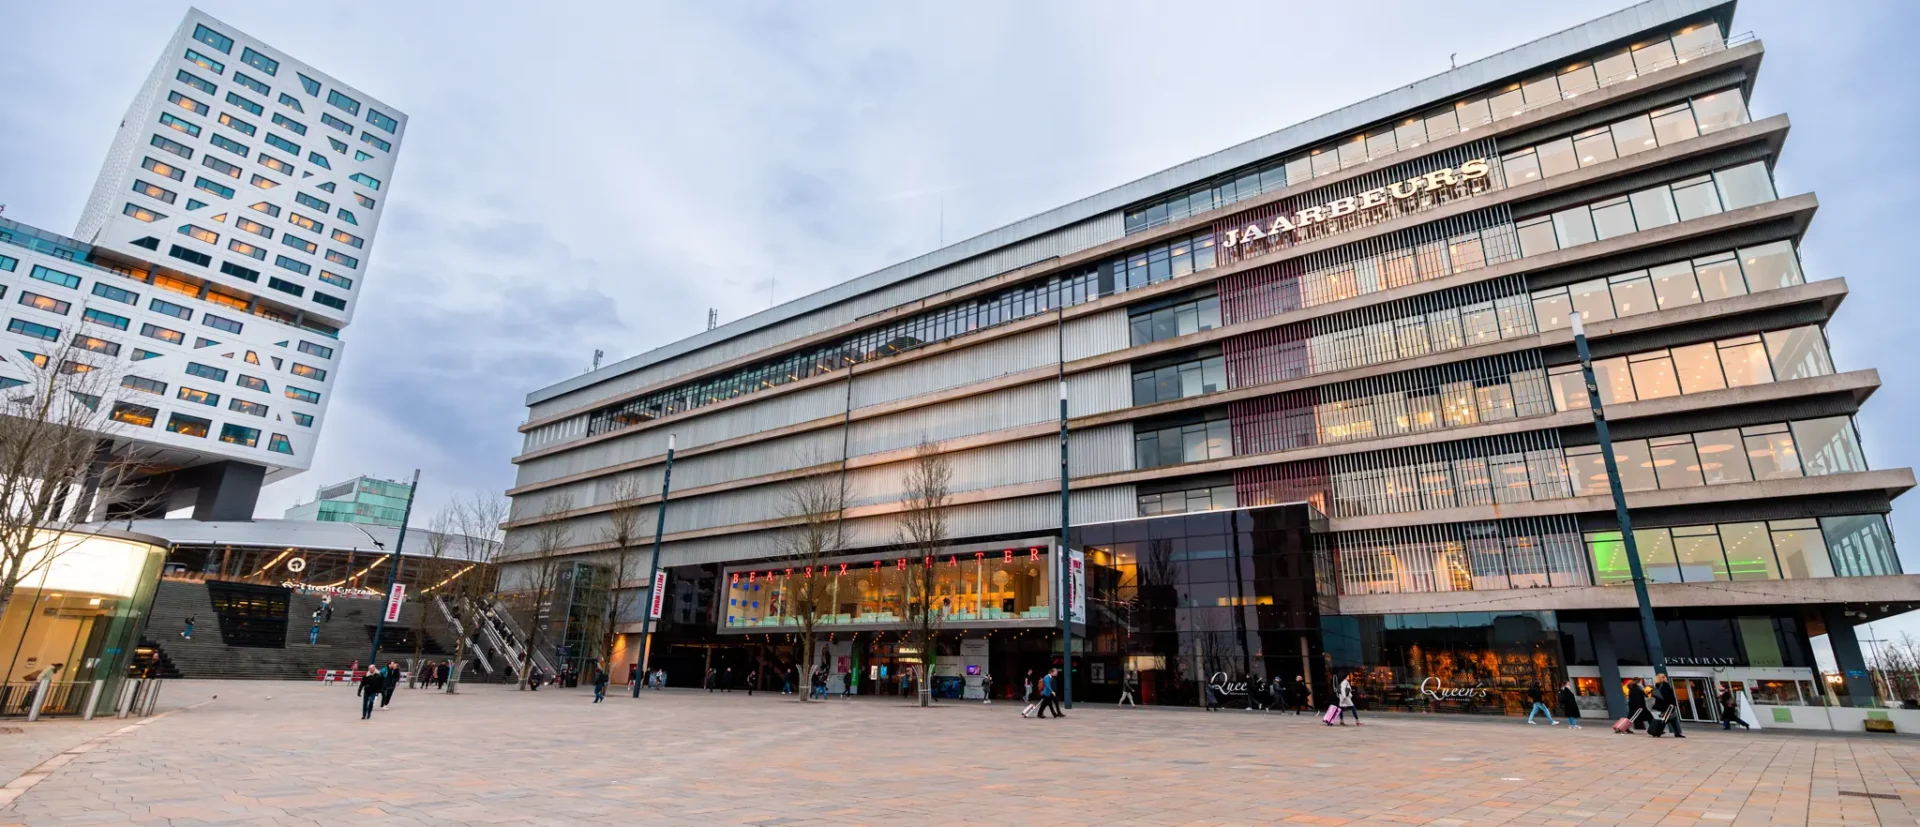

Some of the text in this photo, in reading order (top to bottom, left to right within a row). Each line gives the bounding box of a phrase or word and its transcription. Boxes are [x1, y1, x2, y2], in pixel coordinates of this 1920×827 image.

[1222, 158, 1489, 248] JAARBEURS
[732, 562, 848, 584] BEATRIX
[1664, 657, 1735, 665] ESTAURANT
[1210, 671, 1266, 695] Quee's
[1421, 676, 1487, 701] Queen's
